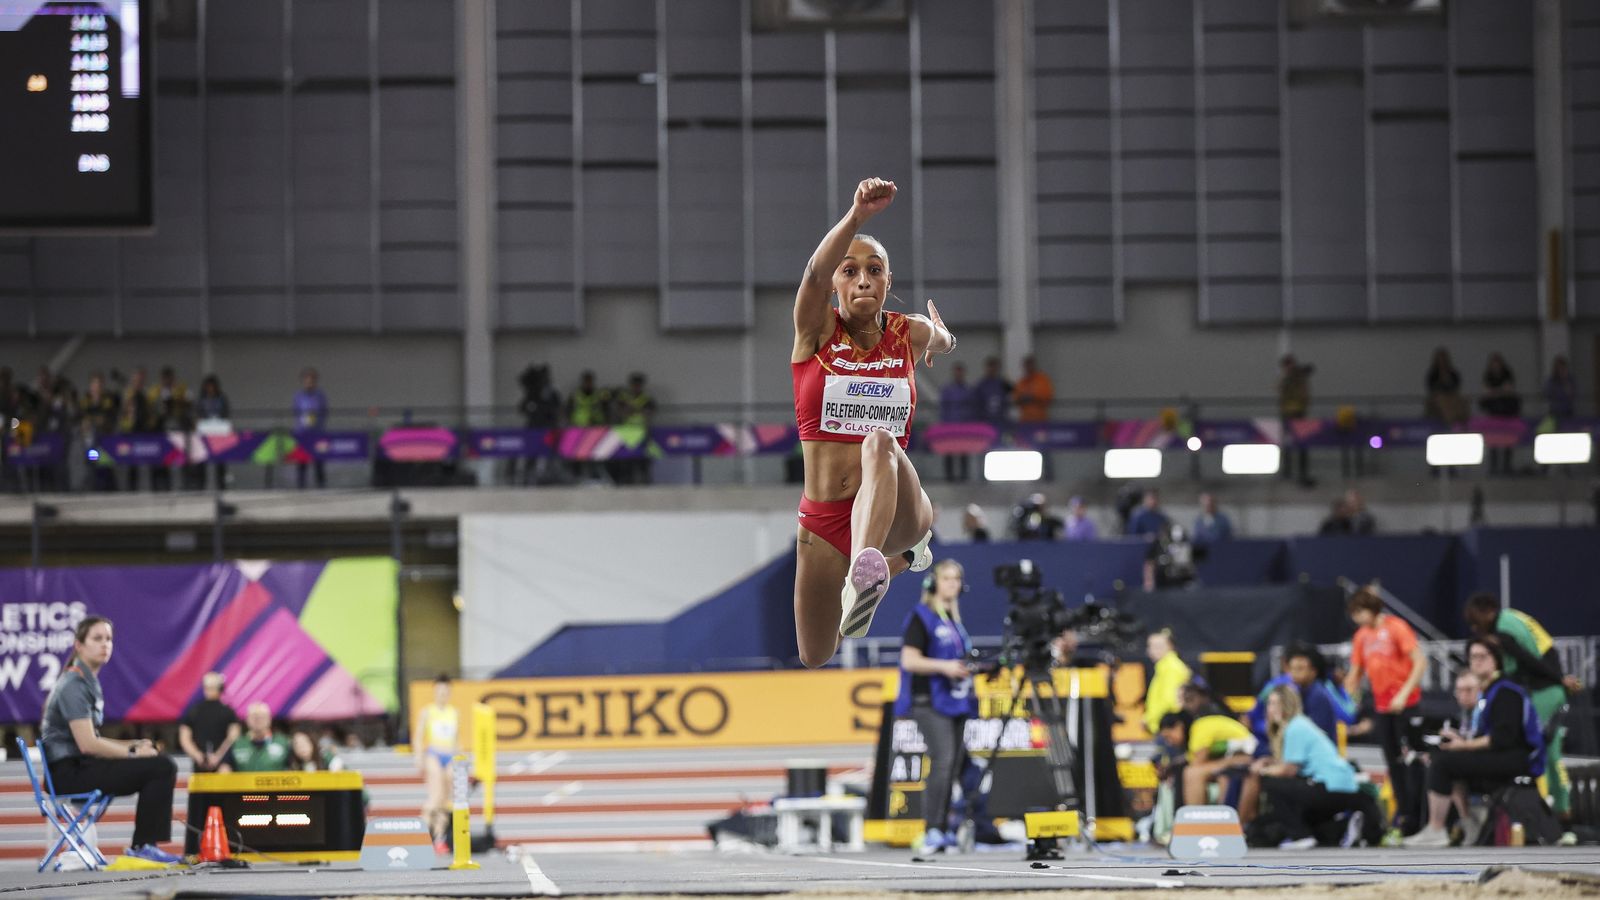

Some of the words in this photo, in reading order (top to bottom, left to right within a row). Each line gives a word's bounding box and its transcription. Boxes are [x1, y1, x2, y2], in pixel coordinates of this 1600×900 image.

[846, 382, 894, 398] HI-CHEW
[825, 402, 909, 422] PELETEIRO-COMPAORÉ
[0, 601, 86, 632] ETICS
[481, 686, 730, 741] SEIKO
